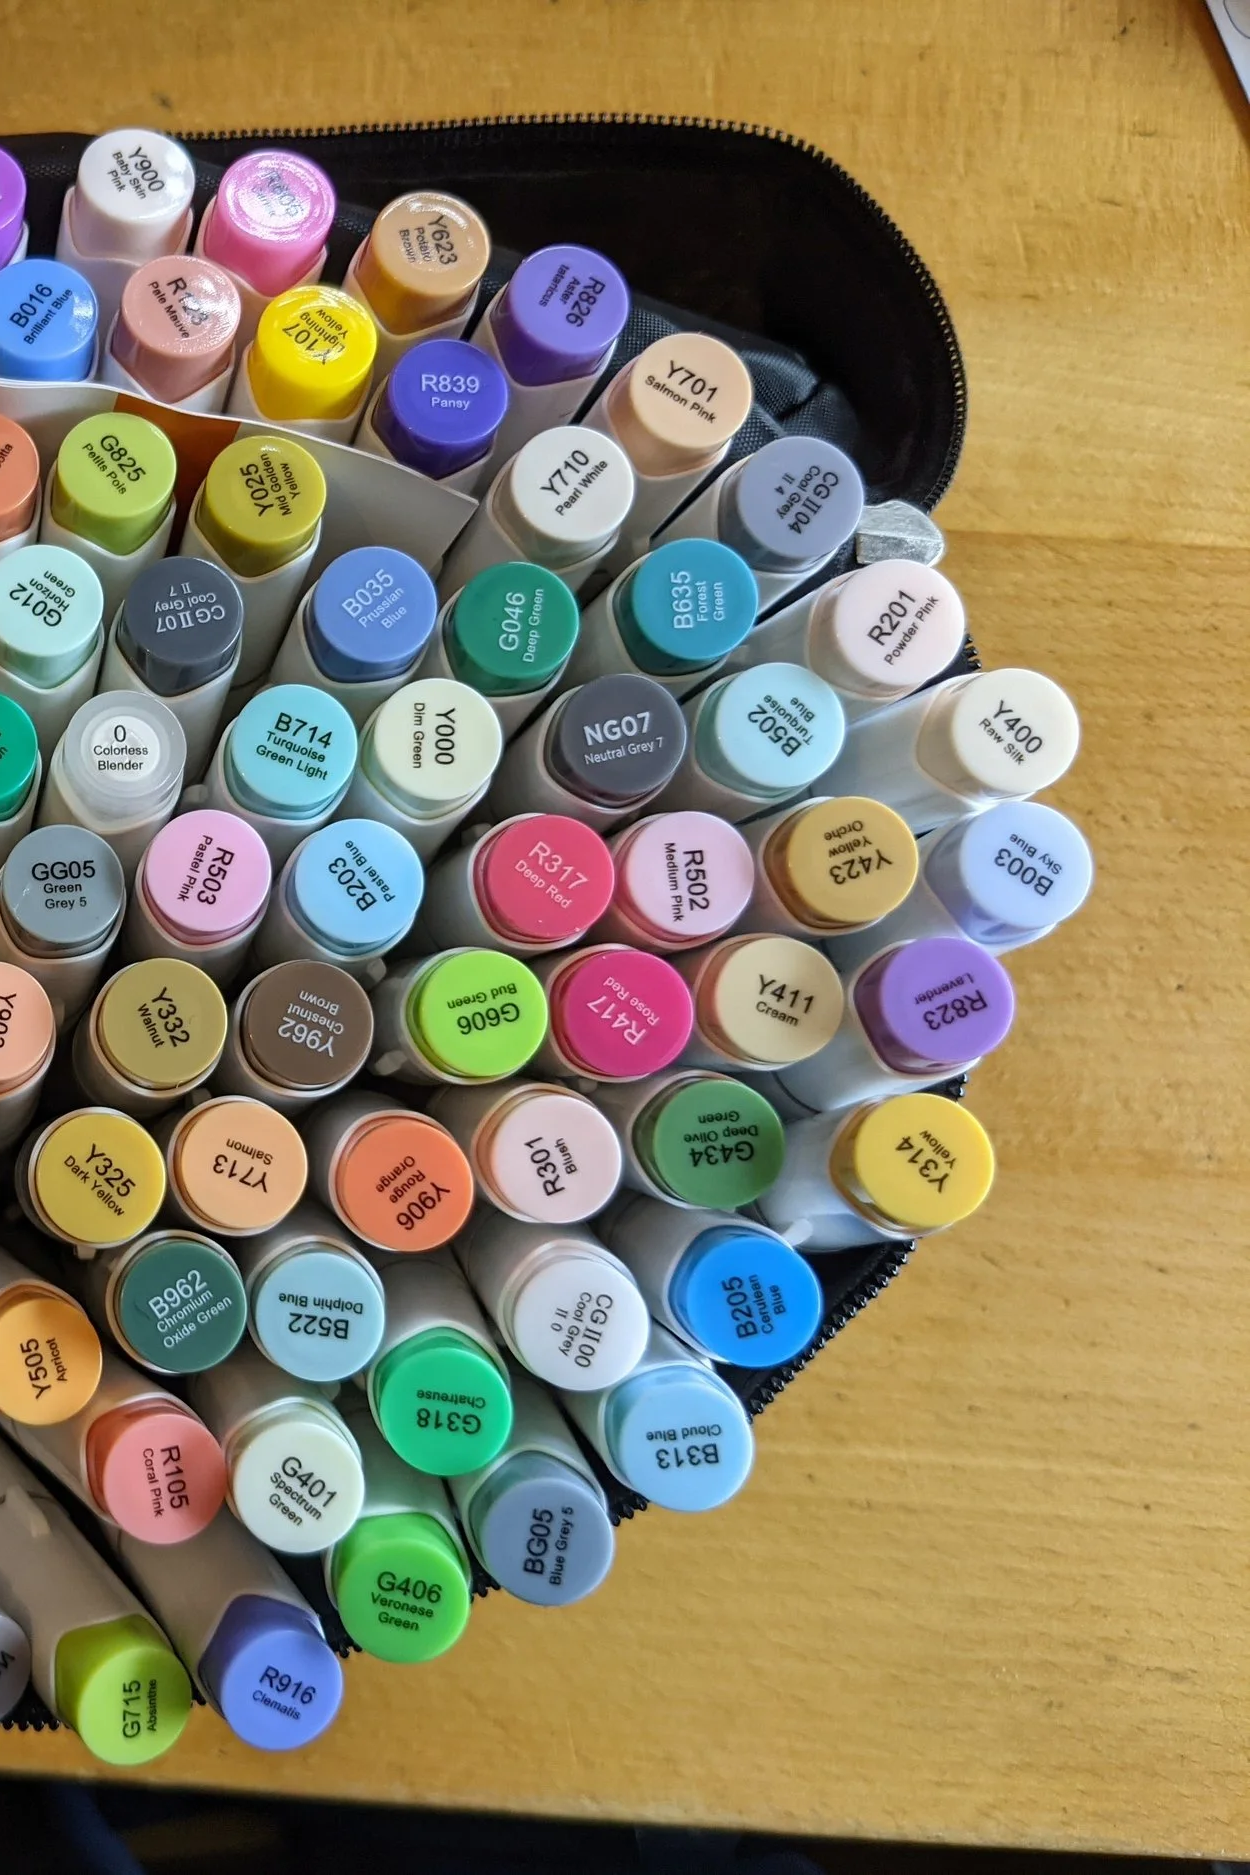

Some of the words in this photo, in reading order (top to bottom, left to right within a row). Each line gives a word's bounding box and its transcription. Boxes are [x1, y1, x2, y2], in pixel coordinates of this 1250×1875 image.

[127, 145, 166, 193] Y900
[8, 282, 54, 329] B016
[22, 308, 57, 346] Brilliant
[50, 288, 73, 311] Blue
[564, 276, 607, 328] R826
[420, 373, 481, 394] R839
[431, 395, 471, 411] Pansy
[644, 374, 689, 407] Salmon
[689, 401, 717, 424] Pink
[666, 359, 719, 403] Y701
[81, 442, 109, 473] Petits
[105, 470, 127, 495] Pois
[99, 434, 147, 483] G825
[539, 449, 590, 496] Y710
[238, 462, 275, 518] Y025
[8, 582, 63, 628] G012
[28, 577, 71, 613] Horizon
[42, 570, 76, 599] Green
[341, 568, 394, 619] B035
[669, 570, 695, 630] B635
[498, 591, 527, 652] G046
[866, 589, 917, 647] R201
[113, 724, 128, 744] 0
[266, 730, 327, 764] Turquoise
[273, 711, 333, 750] B714
[433, 707, 456, 766] Y000
[583, 710, 651, 747] NG07
[747, 703, 803, 758] B502
[978, 717, 1005, 744] Raw
[1005, 742, 1025, 765] Silk
[992, 699, 1044, 754] Y400
[92, 744, 149, 757] Colorless
[97, 759, 144, 771] Blender
[30, 859, 97, 882] GG05
[196, 846, 236, 906] R503
[327, 856, 378, 913] B203
[527, 840, 589, 890] R317
[682, 849, 711, 912] R502
[828, 848, 894, 886] Y423
[993, 847, 1055, 898] B003
[298, 990, 340, 1017] Brown
[758, 973, 815, 1015] Y411
[914, 972, 975, 1006] Lavender
[922, 988, 989, 1032] R823
[137, 1002, 166, 1049] Walnut
[151, 986, 191, 1048] Y332
[277, 1016, 334, 1058] Y962
[286, 1002, 345, 1036] Chestnut
[456, 1001, 521, 1036] G606
[586, 995, 647, 1046] R417
[755, 1000, 800, 1027] Cream
[85, 1142, 137, 1198] Y325
[225, 1138, 274, 1166] Salmon
[523, 1136, 566, 1197] R301
[554, 1137, 578, 1175] Blush
[688, 1140, 755, 1168] G434
[894, 1135, 950, 1194] Y314
[919, 1129, 957, 1170] Yellow
[63, 1154, 91, 1184] Dark
[90, 1179, 125, 1217] Yellow
[212, 1153, 268, 1194] Y713
[395, 1181, 452, 1232] Y906
[147, 1269, 208, 1320] B962
[720, 1275, 759, 1340] B205
[287, 1311, 350, 1341] B522
[19, 1337, 52, 1401] Y505
[45, 1337, 68, 1383] Apricot
[415, 1389, 487, 1410] Chatreuse
[416, 1407, 482, 1436] G318
[159, 1444, 190, 1510] R105
[655, 1442, 720, 1471] B313
[269, 1471, 323, 1521] Spectrum
[280, 1455, 338, 1508] G401
[268, 1492, 304, 1527] Green
[522, 1507, 555, 1576] BG05
[370, 1591, 435, 1619] Veronese
[376, 1570, 443, 1605] G406
[377, 1610, 420, 1632] Green
[146, 1678, 158, 1733] Absinthe
[251, 1689, 301, 1721] Clematis
[258, 1664, 317, 1706] R916
[121, 1679, 142, 1740] G715
